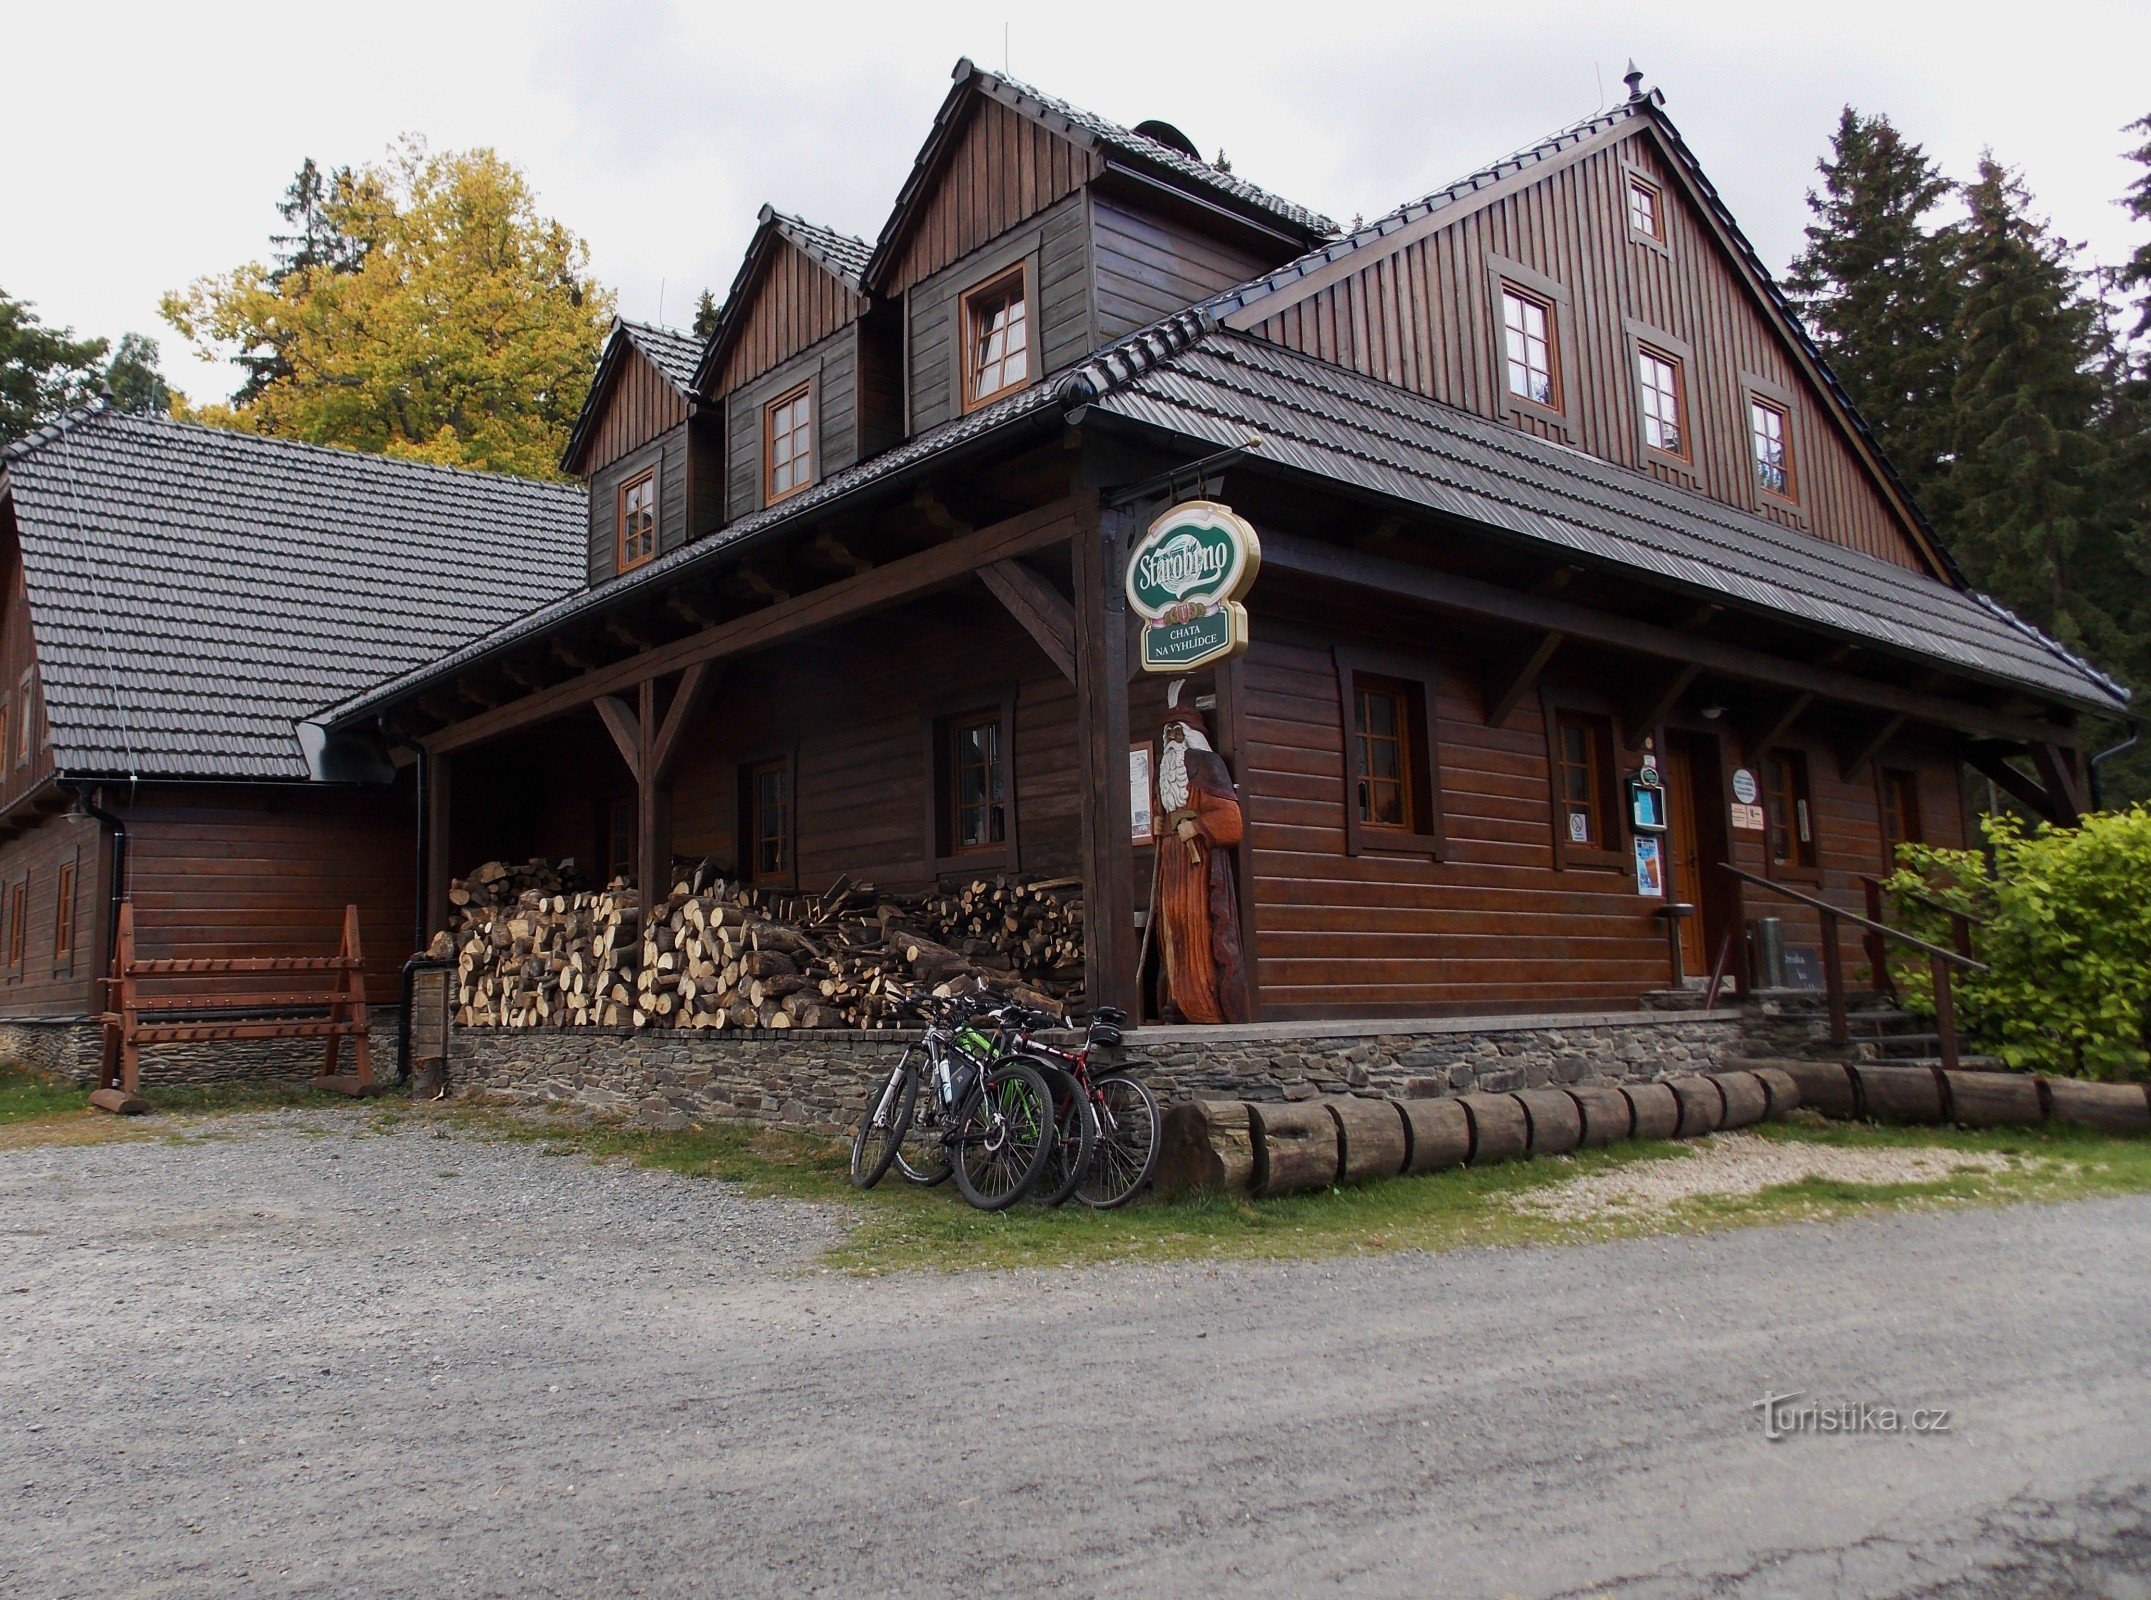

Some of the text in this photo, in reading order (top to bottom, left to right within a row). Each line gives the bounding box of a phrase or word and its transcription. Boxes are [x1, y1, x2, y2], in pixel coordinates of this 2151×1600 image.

[1139, 542, 1227, 599] Starobrno
[1170, 625, 1201, 640] CHATA
[1155, 633, 1218, 657] NA VYHLÍDCE
